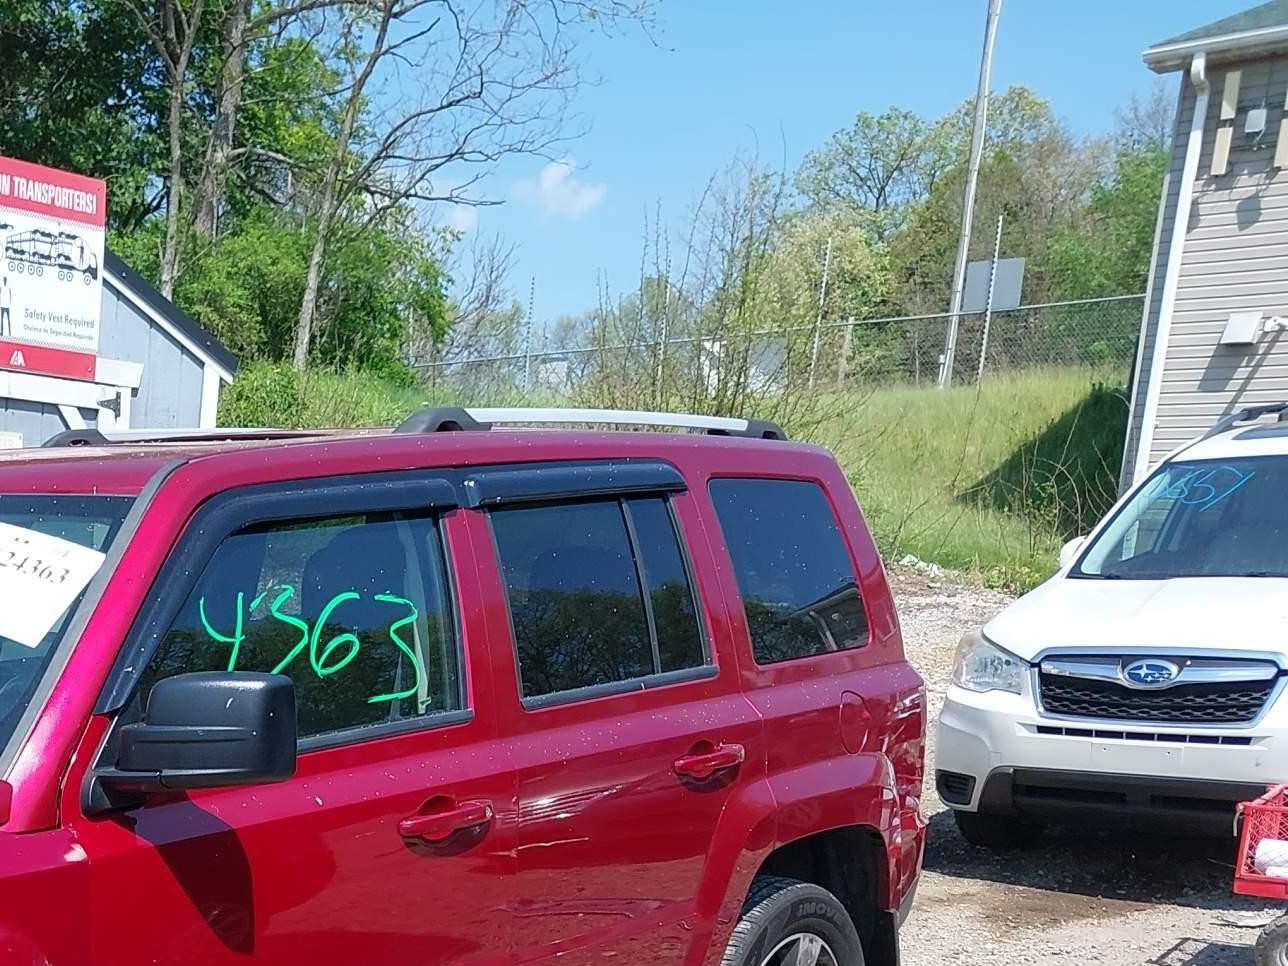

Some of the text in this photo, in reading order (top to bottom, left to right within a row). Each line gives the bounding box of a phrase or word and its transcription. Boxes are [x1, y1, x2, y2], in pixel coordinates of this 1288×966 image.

[13, 176, 97, 215] TRANSPORTERS!
[24, 307, 95, 329] Safety Vest Required
[199, 584, 422, 704] 4363
